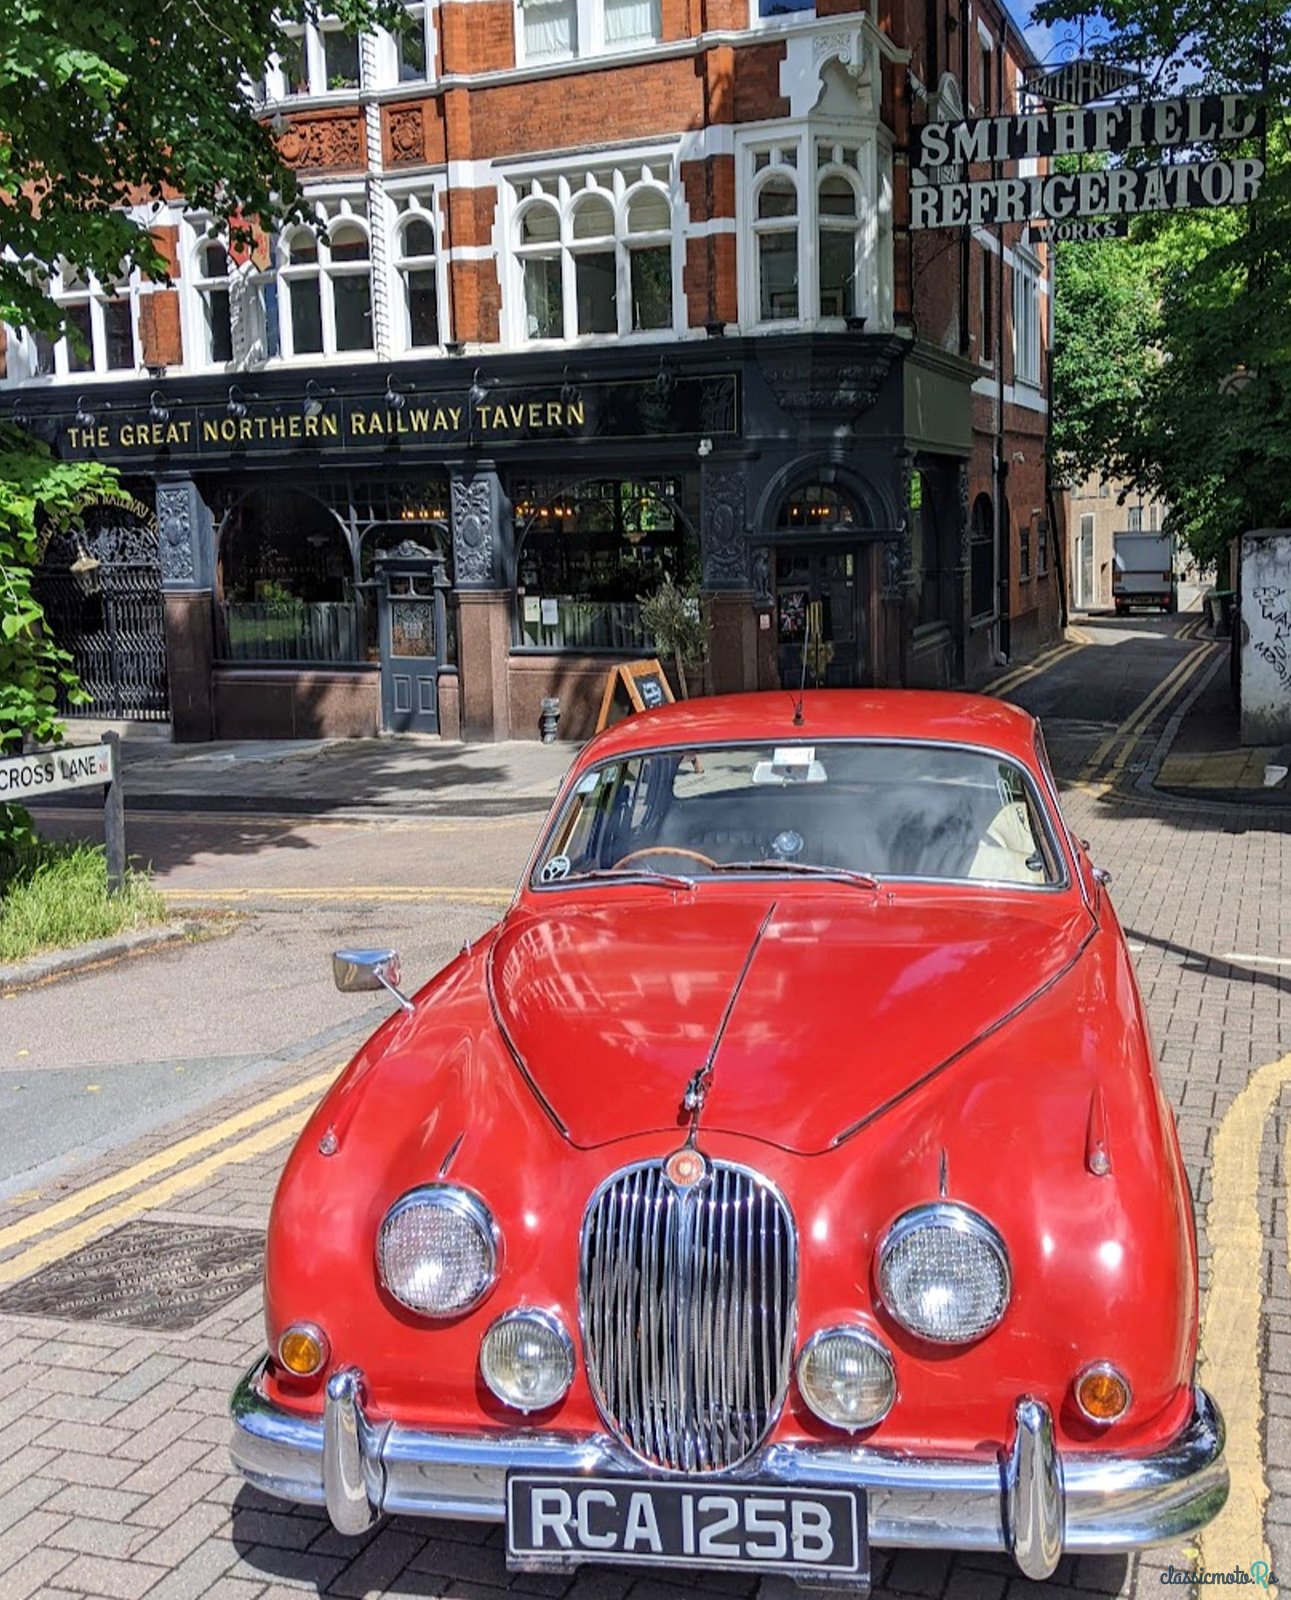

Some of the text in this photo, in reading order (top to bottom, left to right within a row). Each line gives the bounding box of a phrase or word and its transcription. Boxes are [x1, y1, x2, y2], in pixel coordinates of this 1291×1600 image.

[920, 94, 1257, 167] SMITHFIELD
[908, 159, 1266, 230] REFRIGERATOR
[1039, 220, 1117, 241] WORKS
[67, 401, 585, 448] THE GREAT NORTHERN RAILWAY TAVERN
[0, 762, 54, 790] CROSS
[60, 755, 97, 780] LANE
[530, 1487, 834, 1562] RCA 125B
